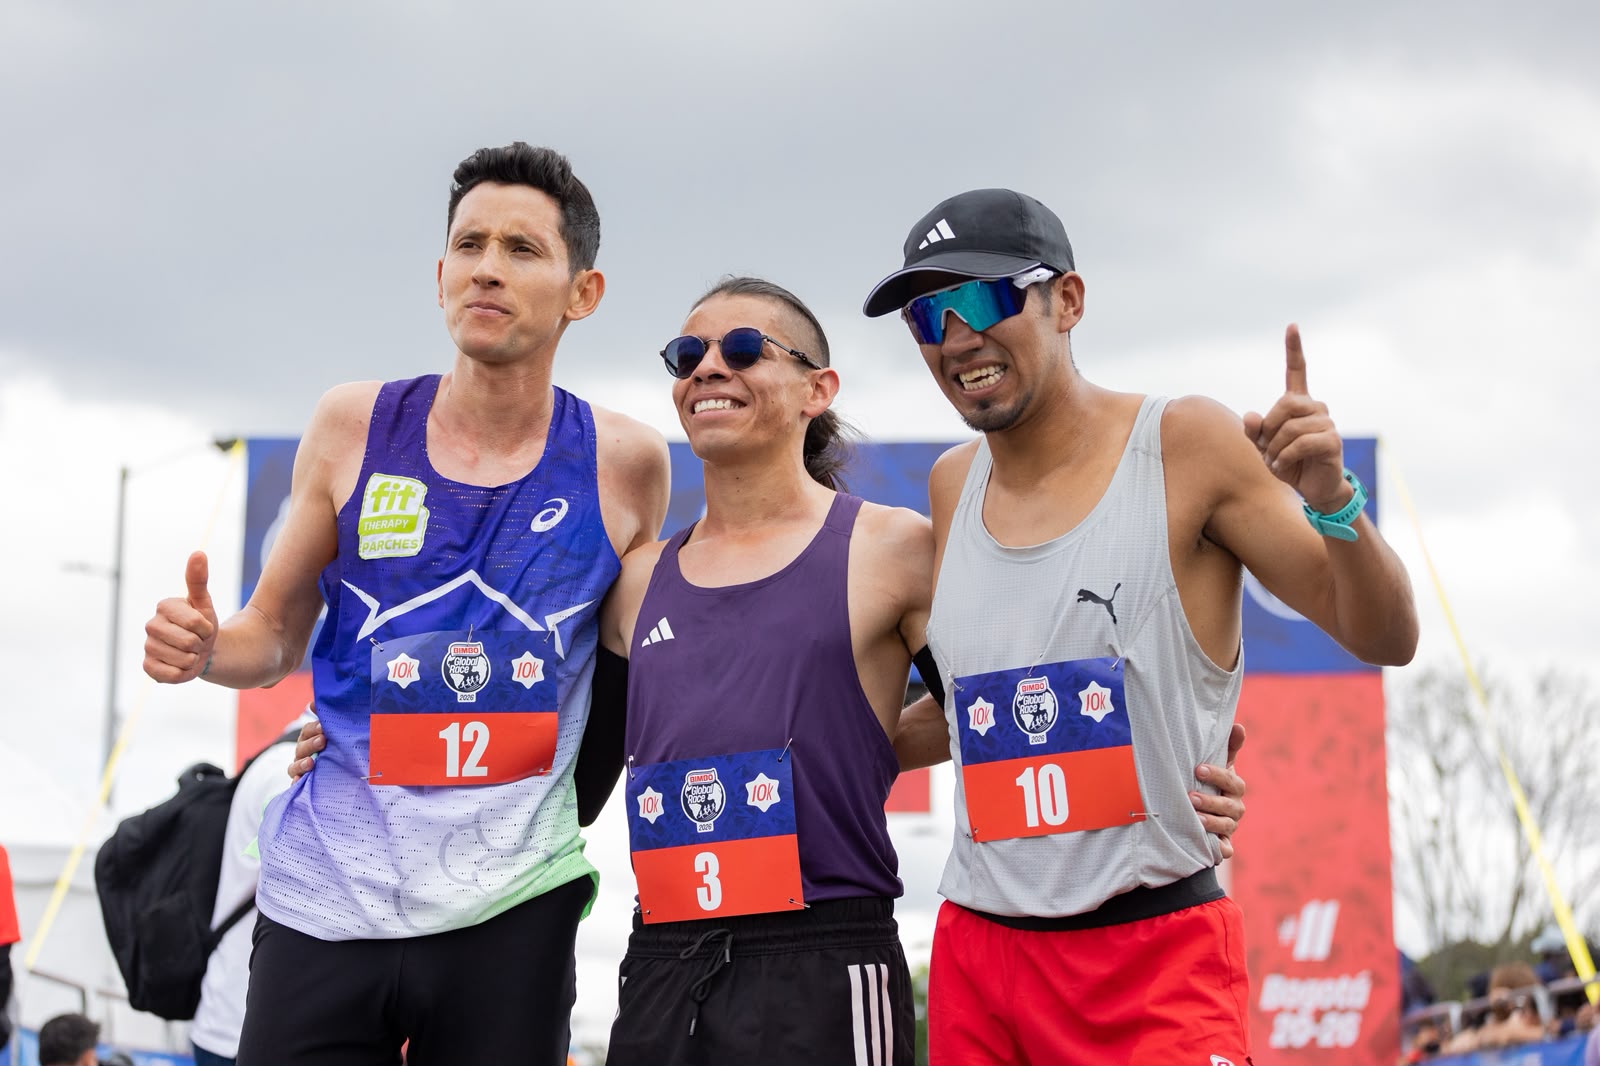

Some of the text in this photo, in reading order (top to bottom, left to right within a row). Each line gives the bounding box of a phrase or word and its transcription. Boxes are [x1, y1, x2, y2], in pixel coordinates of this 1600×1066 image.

[371, 481, 416, 512] fit
[363, 519, 409, 531] THERAPY
[362, 539, 418, 553] PARCHES
[453, 656, 479, 666] Global
[449, 664, 470, 674] Race
[1021, 682, 1045, 693] BIMBO
[1022, 693, 1046, 706] Global
[1019, 703, 1038, 714] Race
[1031, 735, 1045, 743] 2026
[438, 721, 490, 778] 12
[689, 773, 714, 783] BIMBO
[691, 784, 714, 796] Global
[1015, 763, 1069, 828] 10
[687, 793, 706, 804] Race
[698, 823, 713, 832] 2026
[694, 851, 722, 911] 3
